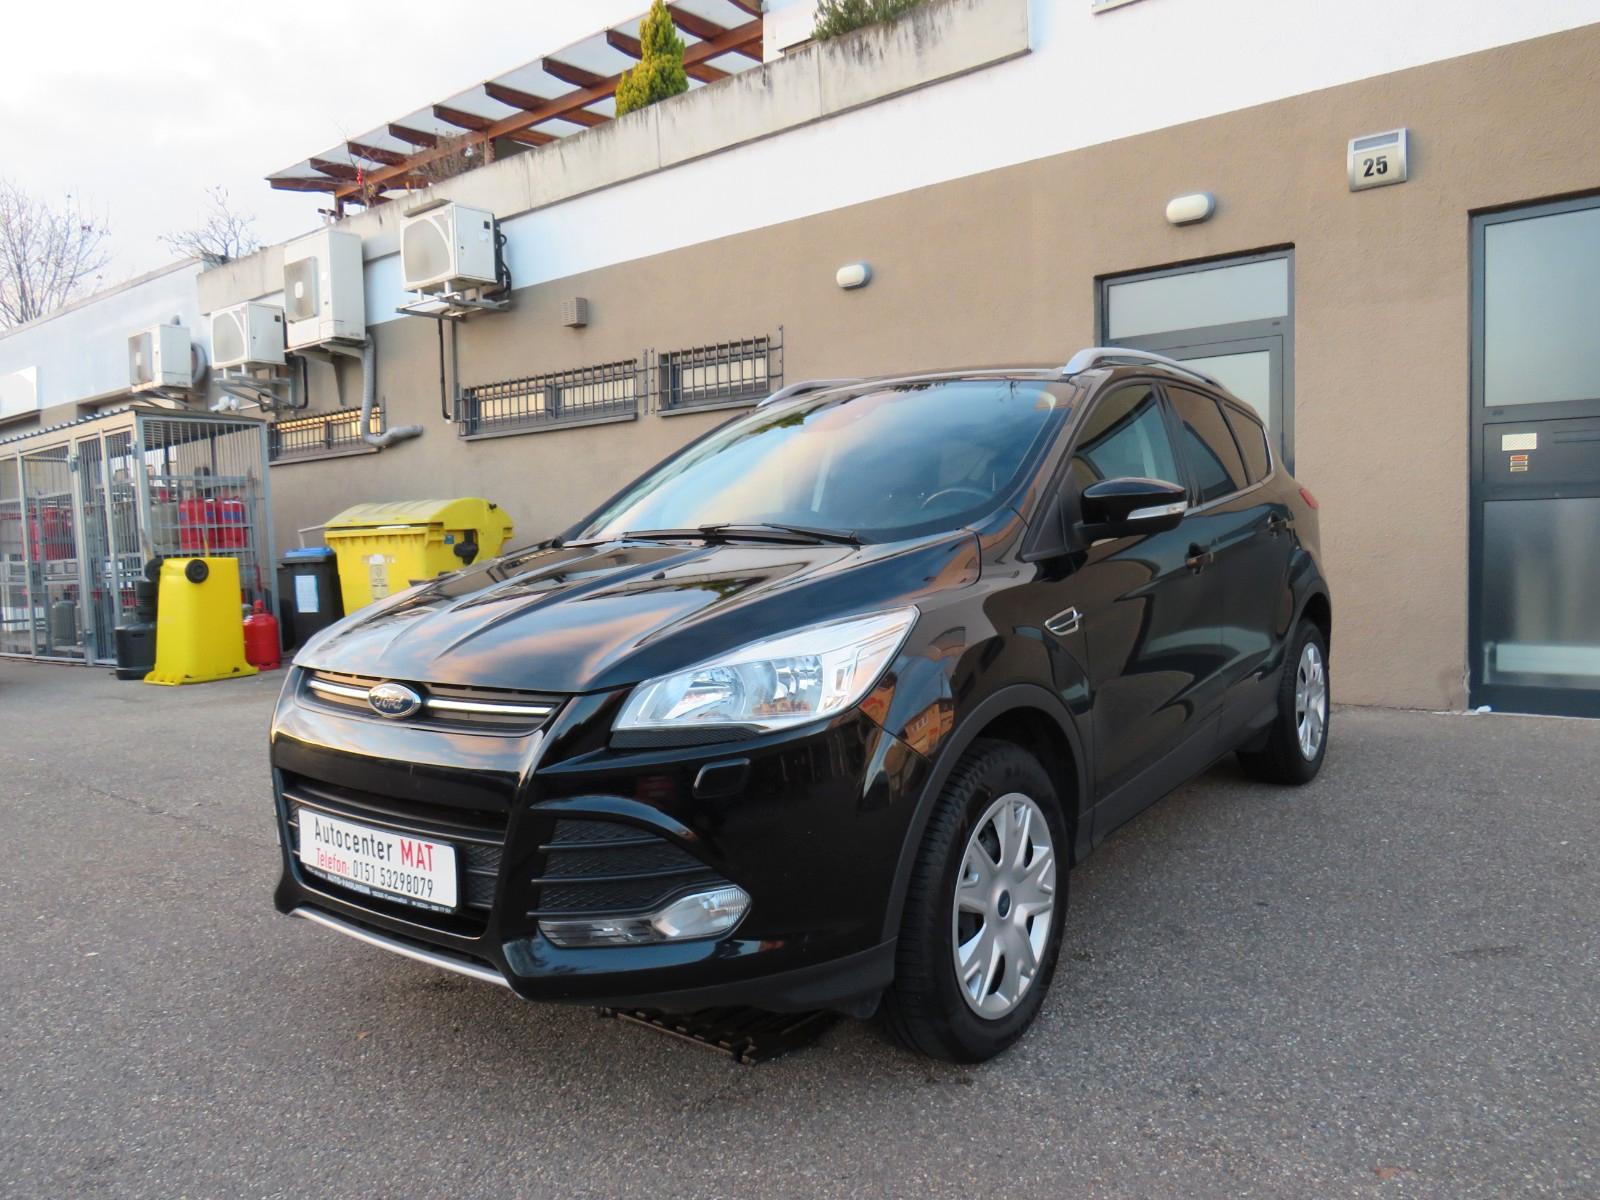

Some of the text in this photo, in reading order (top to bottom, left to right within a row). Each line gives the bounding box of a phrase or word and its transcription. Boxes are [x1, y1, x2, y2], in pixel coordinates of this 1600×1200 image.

[1363, 155, 1388, 178] 25
[314, 816, 433, 872] Autocenter MAT
[316, 847, 350, 876] Telefon:
[352, 859, 376, 884] 0151
[380, 867, 433, 899] 53298079
